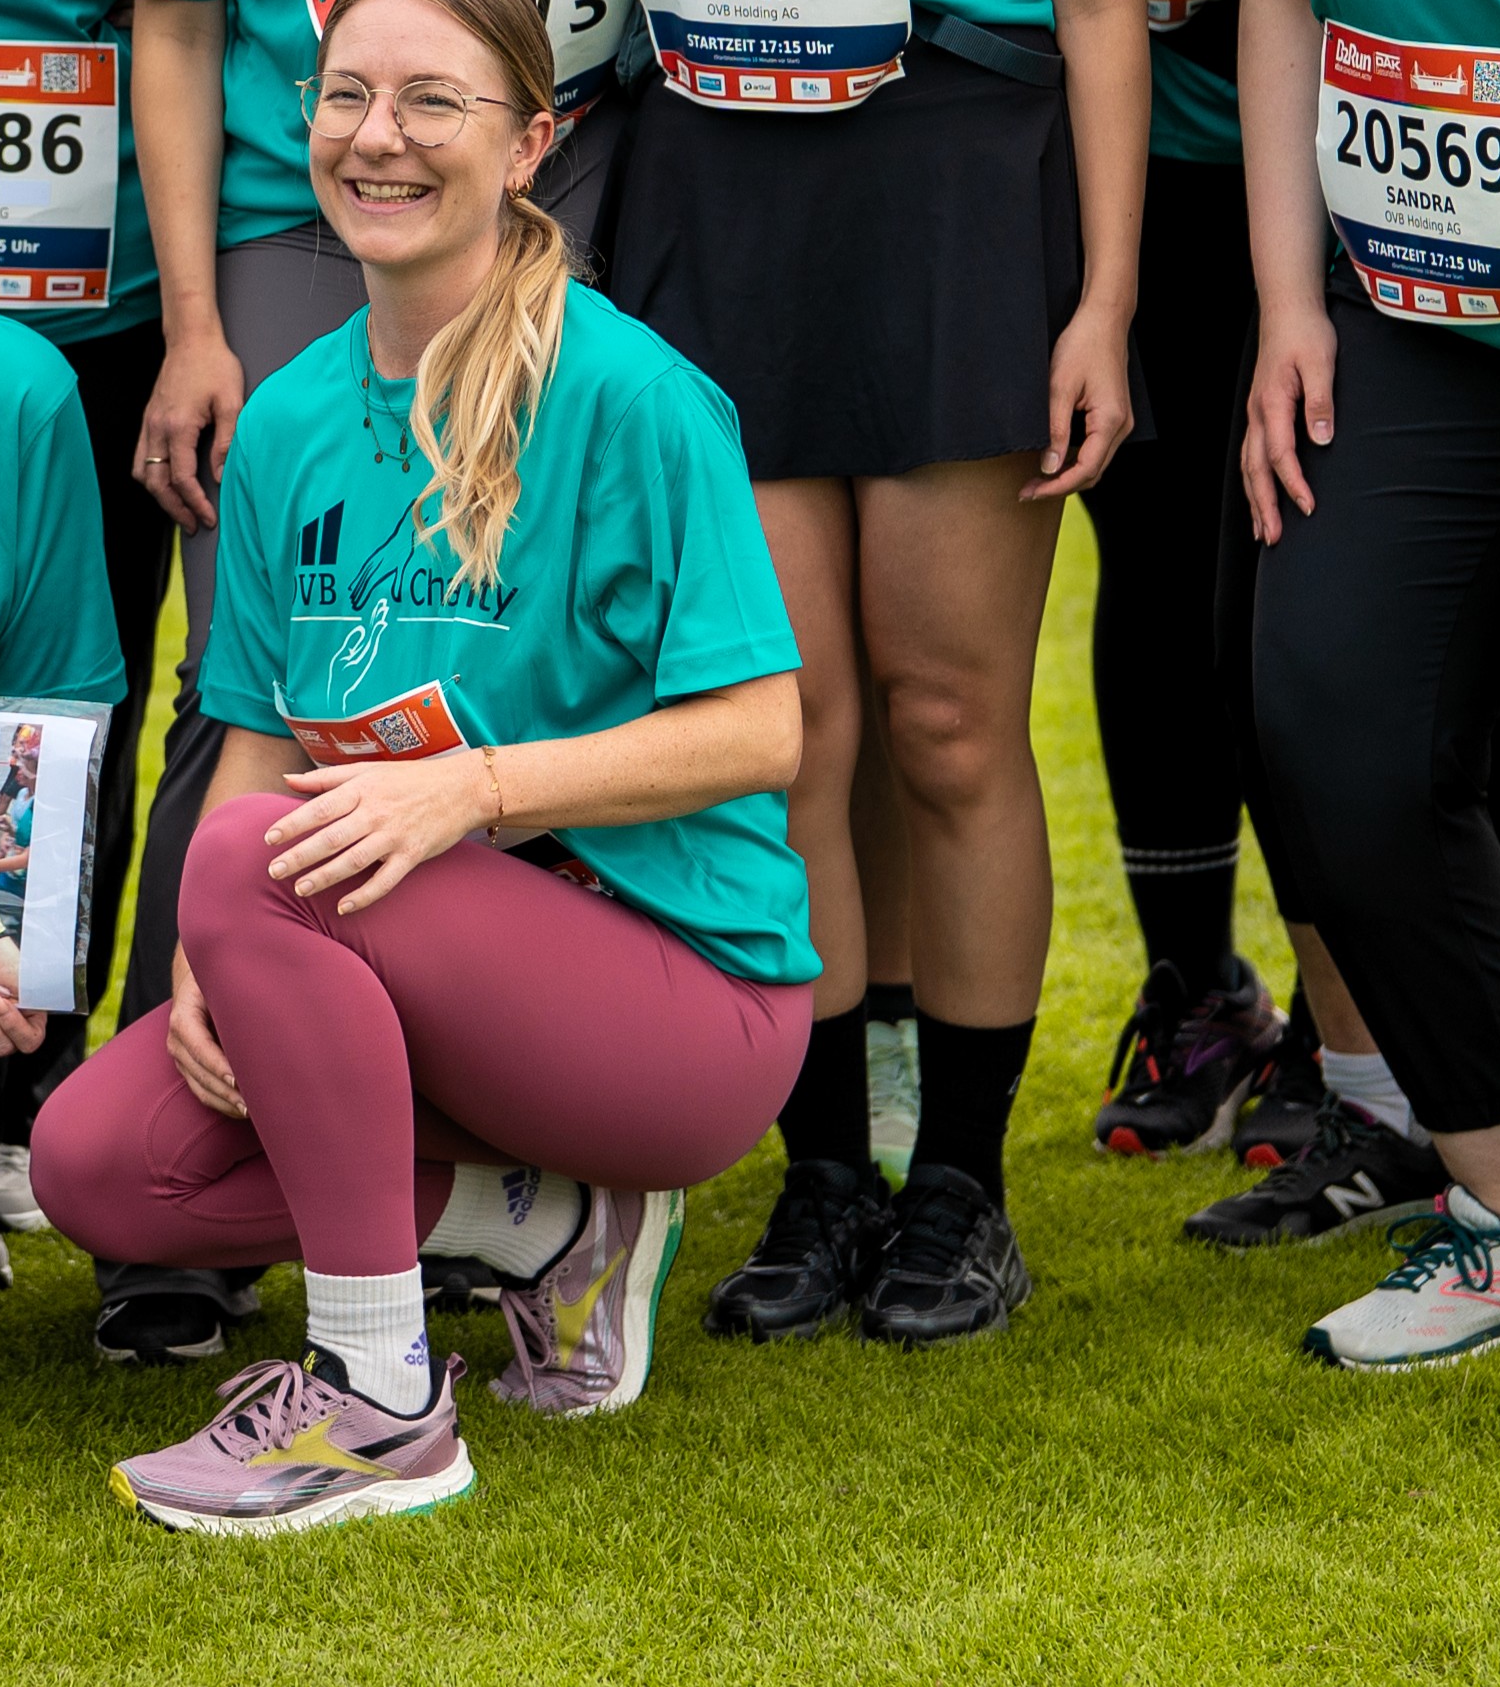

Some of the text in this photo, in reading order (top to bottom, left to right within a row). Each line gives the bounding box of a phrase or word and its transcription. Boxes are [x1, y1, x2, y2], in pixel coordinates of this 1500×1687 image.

[707, 4, 800, 21] OVB Holding AG
[687, 34, 834, 55] STARTZEIT 17:15 Uhr
[1335, 38, 1372, 72] B2Run
[1376, 51, 1400, 69] DAK
[1386, 186, 1456, 214] SANDRA
[1385, 211, 1461, 235] OVB Holding AG
[11, 239, 40, 253] Uhr
[1367, 239, 1427, 264] STARTZEIT
[1430, 252, 1465, 270] 17:15
[1468, 257, 1492, 274] Uhr
